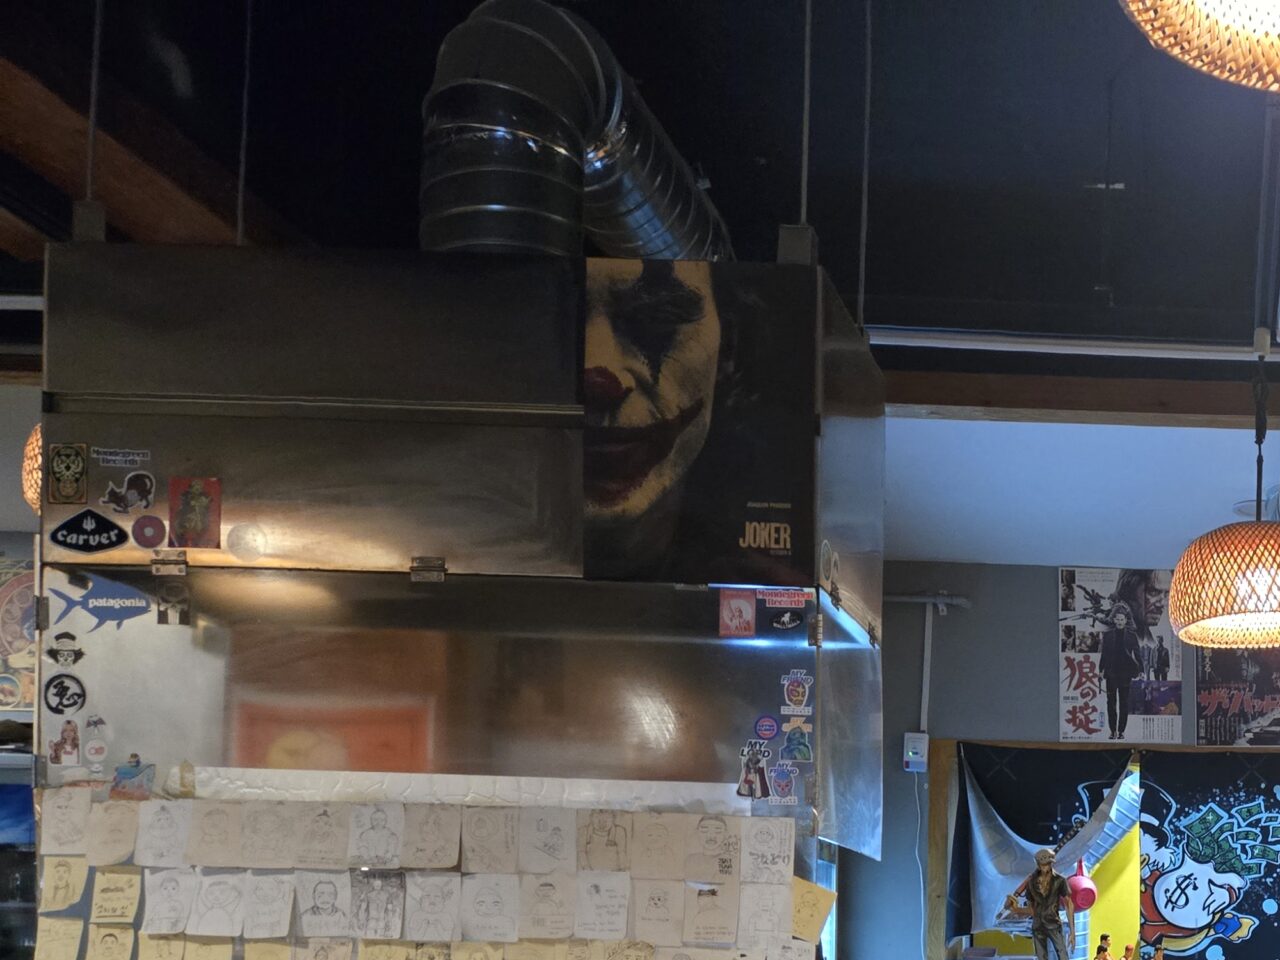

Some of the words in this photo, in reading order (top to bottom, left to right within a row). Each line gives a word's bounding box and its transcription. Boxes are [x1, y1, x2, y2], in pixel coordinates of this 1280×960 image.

[56, 529, 119, 547] carver
[739, 521, 791, 549] JOKER
[88, 597, 146, 610] patagonia
[1061, 654, 1102, 735] 狼の掟
[746, 741, 766, 750] MY
